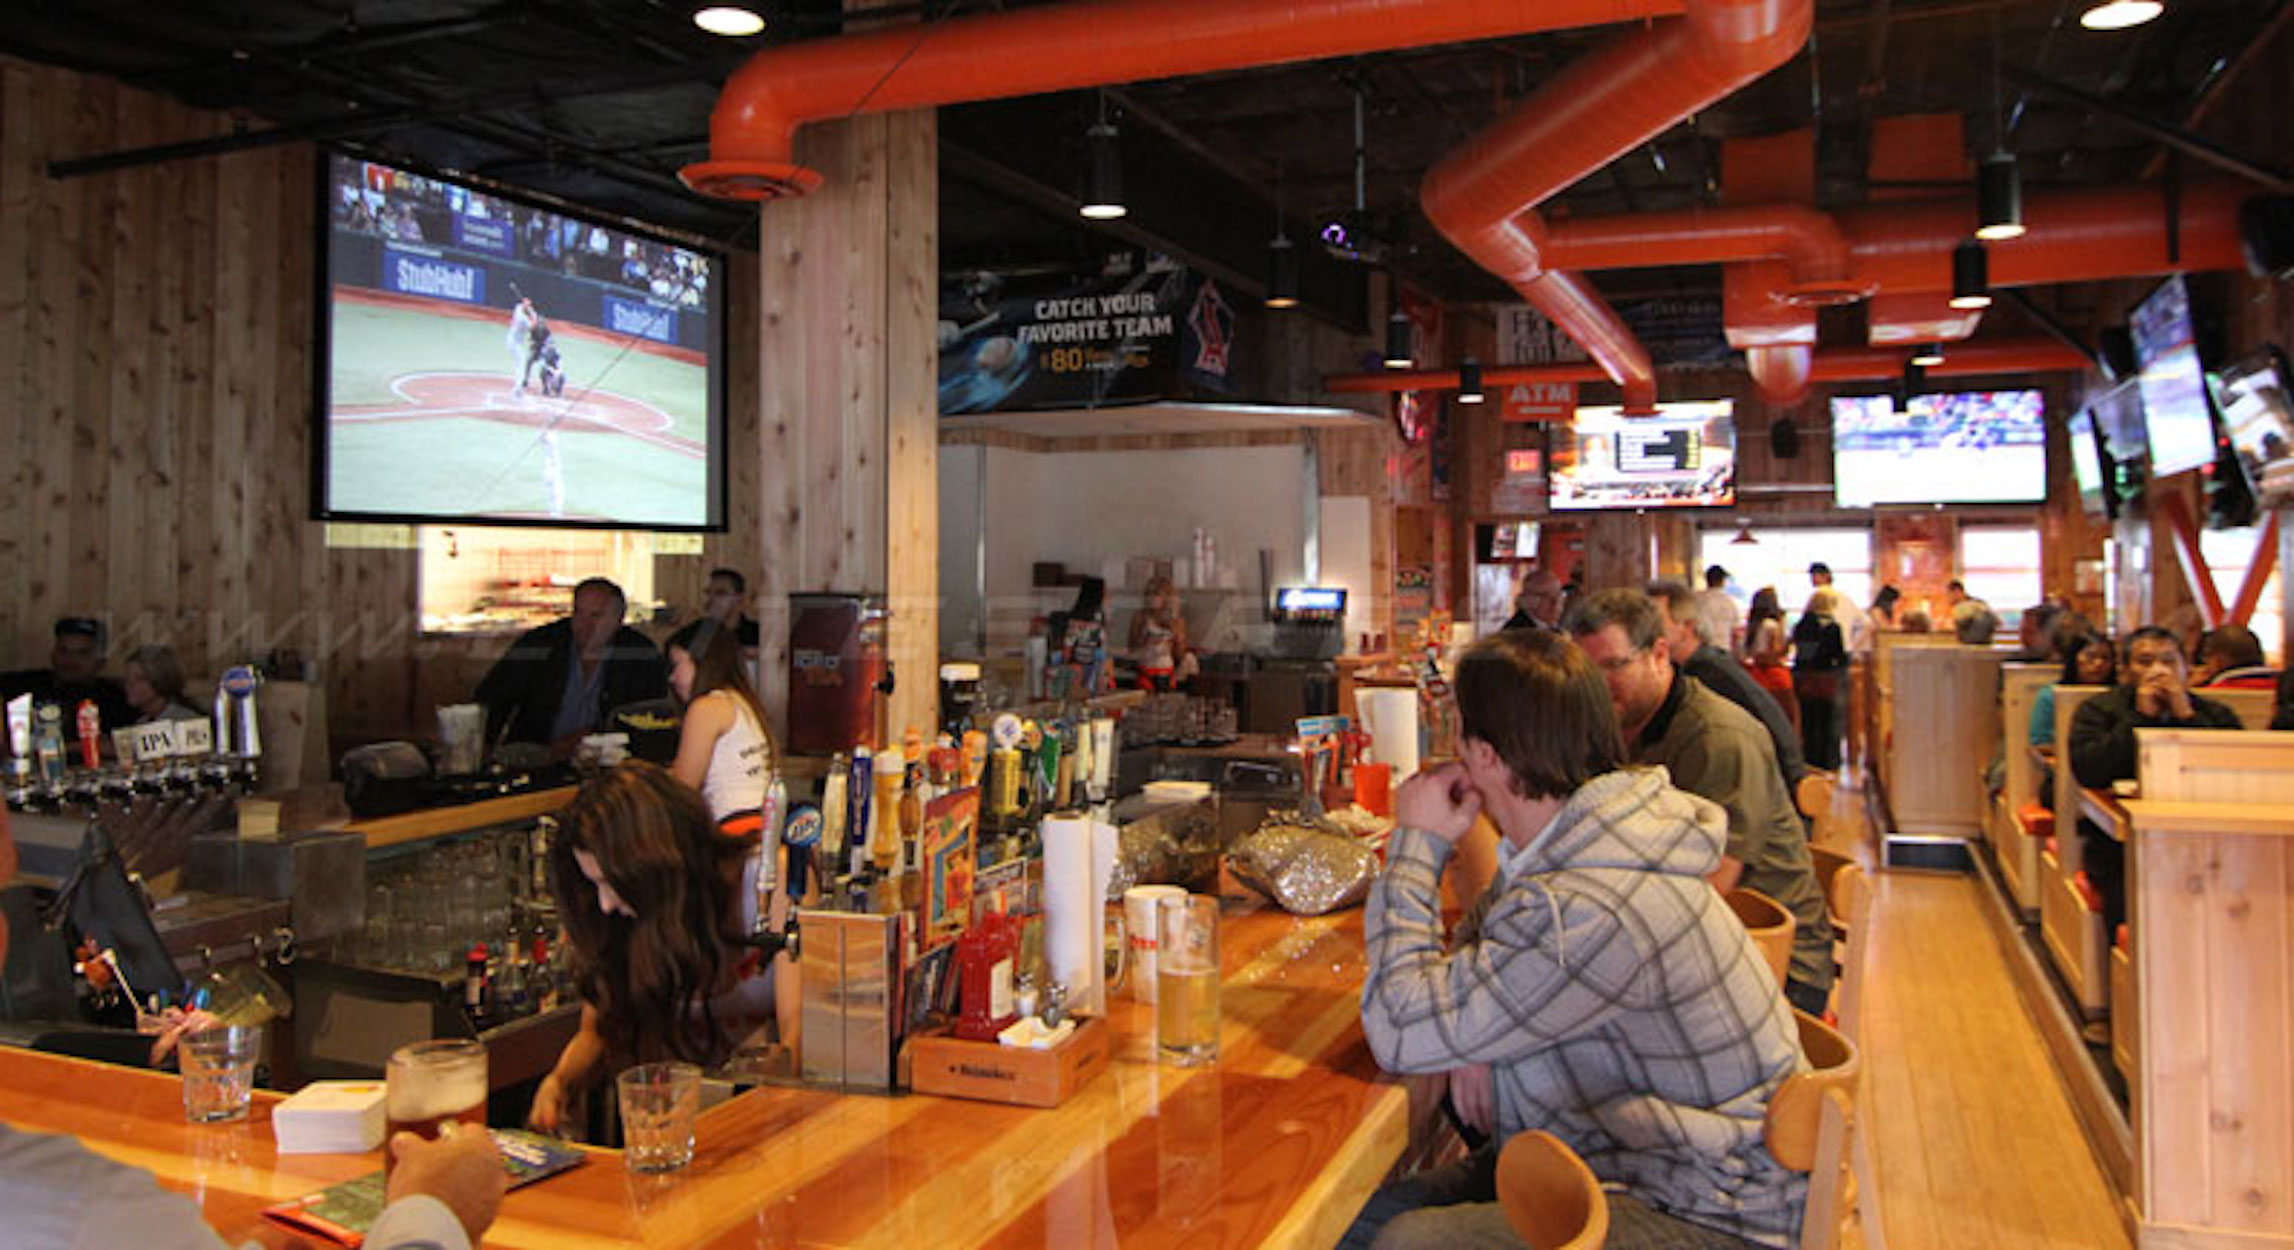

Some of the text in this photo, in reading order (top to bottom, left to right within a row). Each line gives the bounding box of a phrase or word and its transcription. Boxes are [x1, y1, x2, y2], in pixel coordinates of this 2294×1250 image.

[1035, 293, 1156, 319] CATCH YOUR
[1018, 316, 1173, 342] FAVORITE TEAM
[1510, 384, 1571, 403] ATM
[141, 731, 171, 752] IPA
